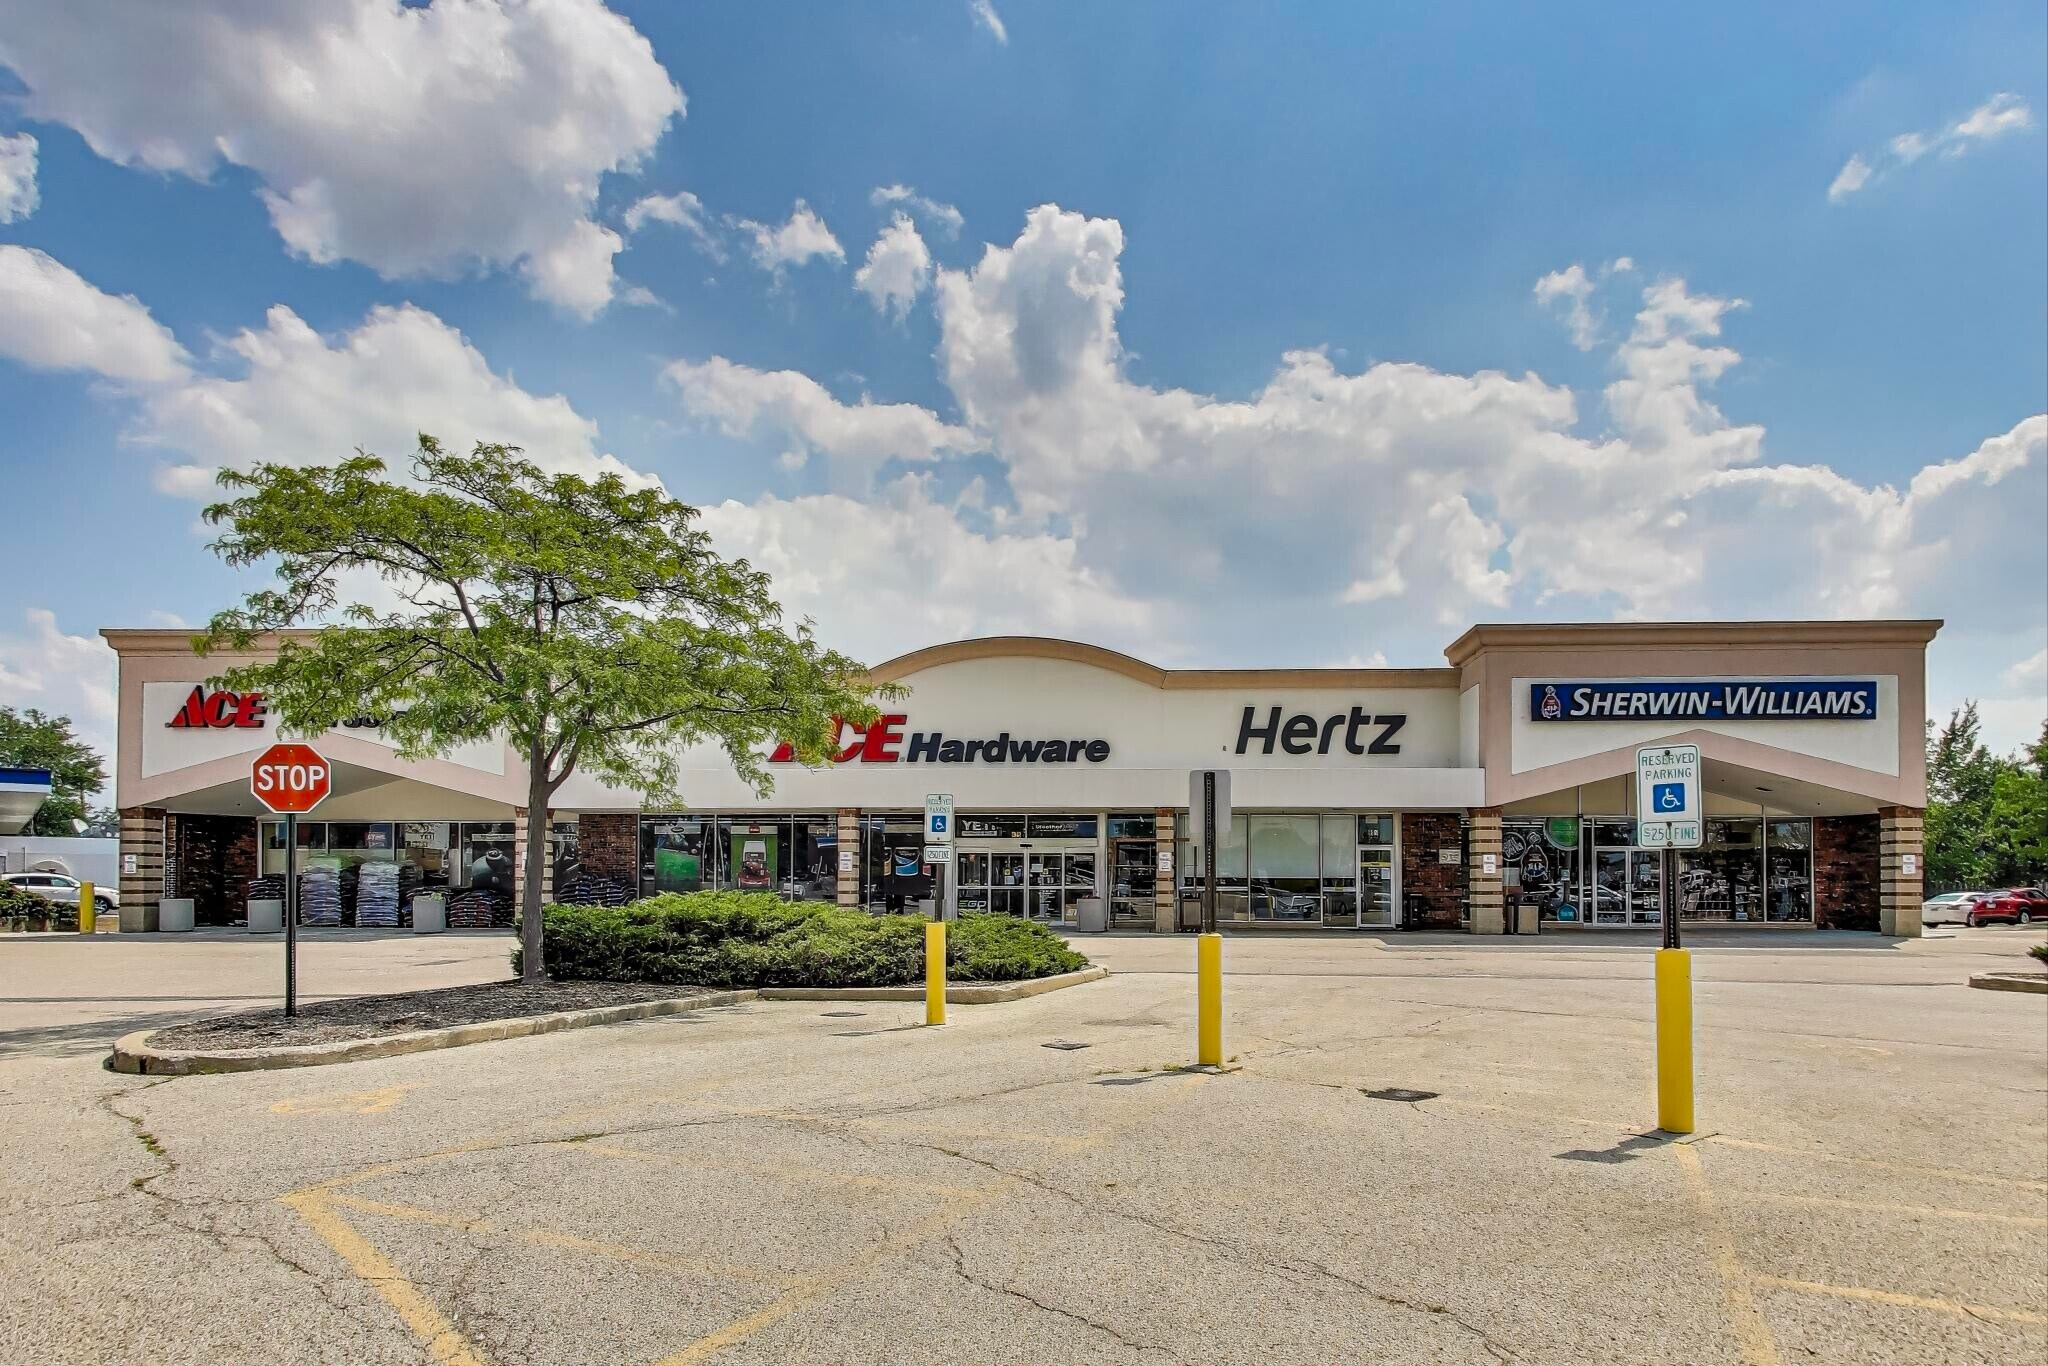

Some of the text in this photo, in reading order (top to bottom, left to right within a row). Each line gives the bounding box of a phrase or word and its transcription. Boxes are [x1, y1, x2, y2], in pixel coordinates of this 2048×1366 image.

[166, 685, 268, 728] ACE
[1570, 687, 1869, 716] SHERWIN-WILLIAMS
[1235, 706, 1407, 755] Hertz
[907, 732, 1111, 763] Hardware
[1641, 752, 1695, 766] RESERVED
[257, 764, 325, 791] STOP
[1645, 768, 1692, 780] PARKING
[1643, 826, 1697, 841] $250 FINE
